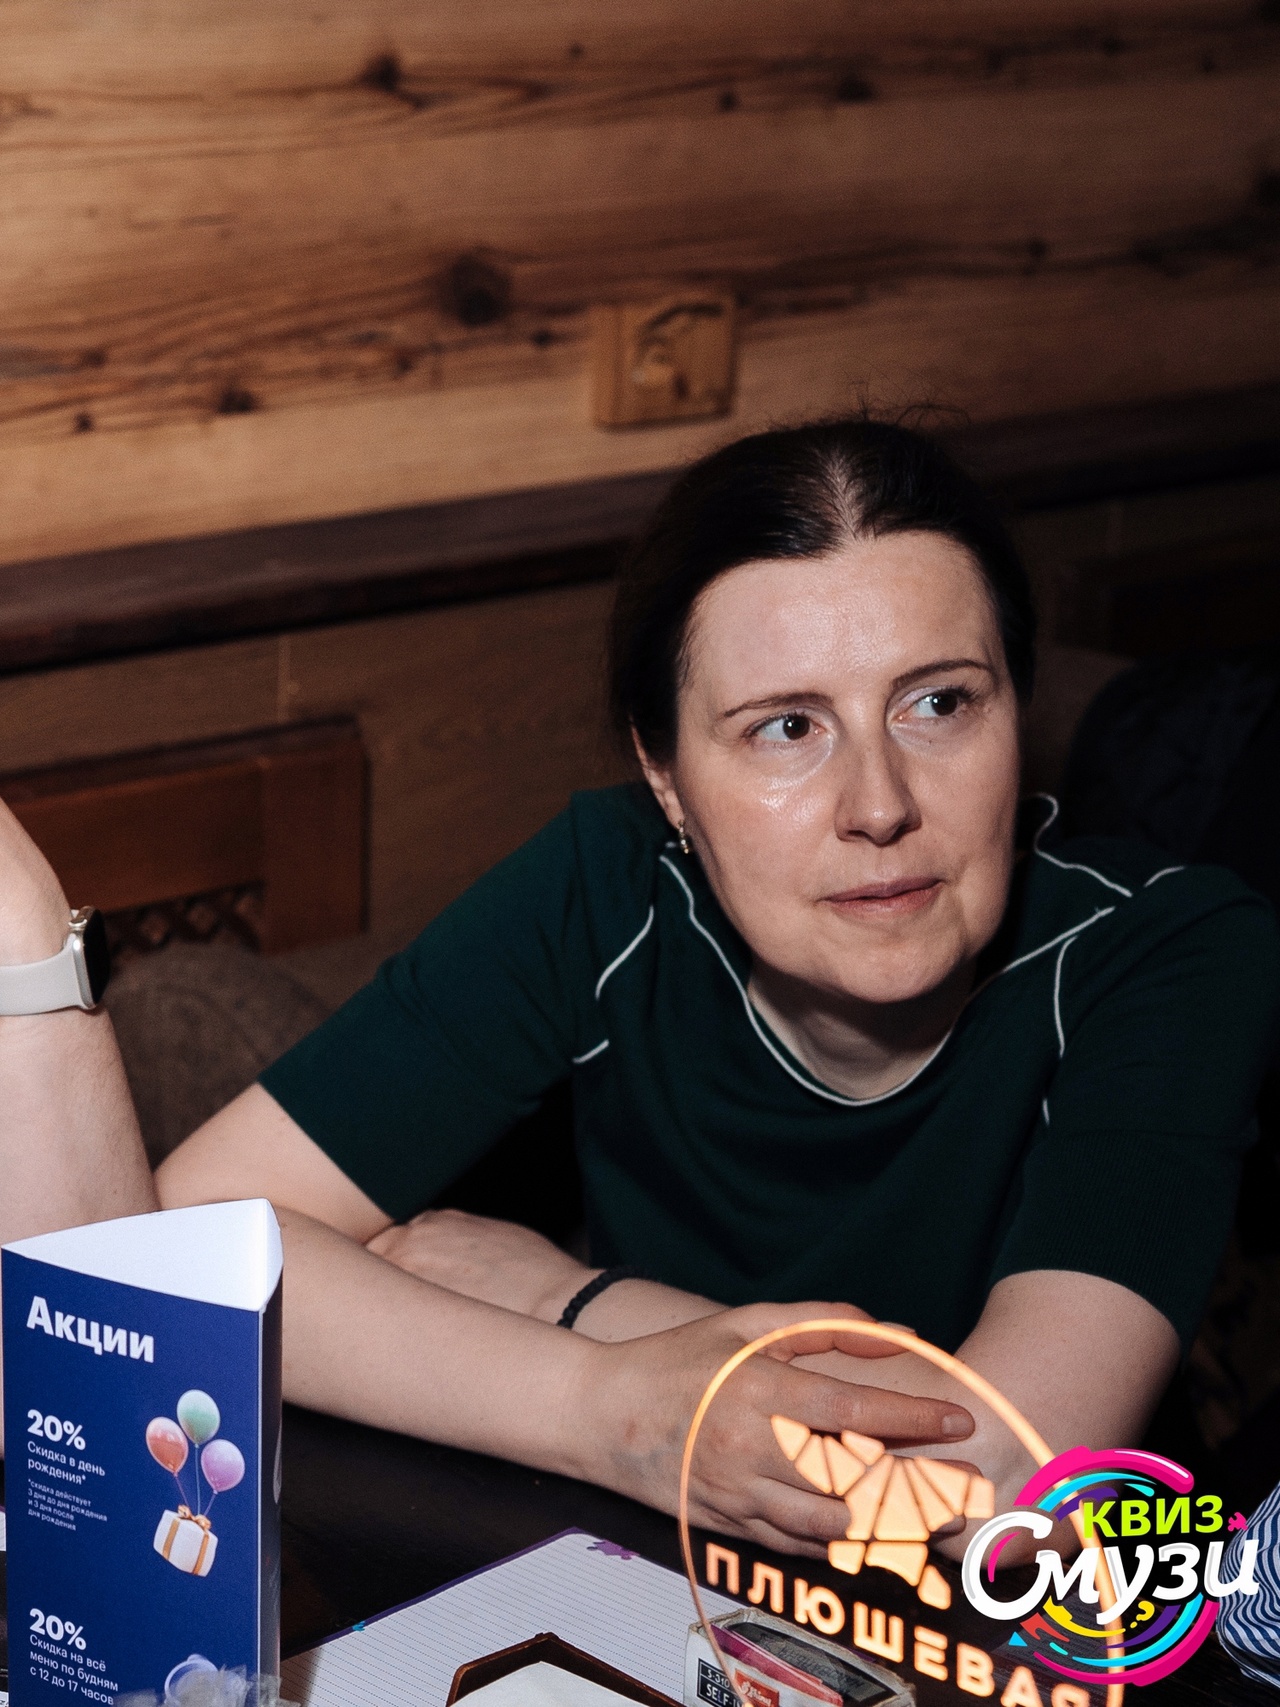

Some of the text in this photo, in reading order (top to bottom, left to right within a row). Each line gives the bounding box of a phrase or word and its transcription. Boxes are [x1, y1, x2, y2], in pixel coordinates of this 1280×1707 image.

[26, 1295, 154, 1364] Акции
[27, 1409, 86, 1451] 20%
[27, 1441, 106, 1477] Скидка в день
[28, 1488, 108, 1522] 3 дня до дня рождения
[34, 1500, 39, 1508] 3
[39, 1503, 52, 1513] дня
[53, 1508, 75, 1521] после
[55, 1490, 91, 1507] действует
[28, 1508, 77, 1531] дня рождения
[29, 1608, 87, 1650] 20%
[29, 1634, 107, 1672] Скидка на всё
[29, 1650, 119, 1692] меню по будням
[29, 1666, 115, 1706] с 12 до 17 часов
